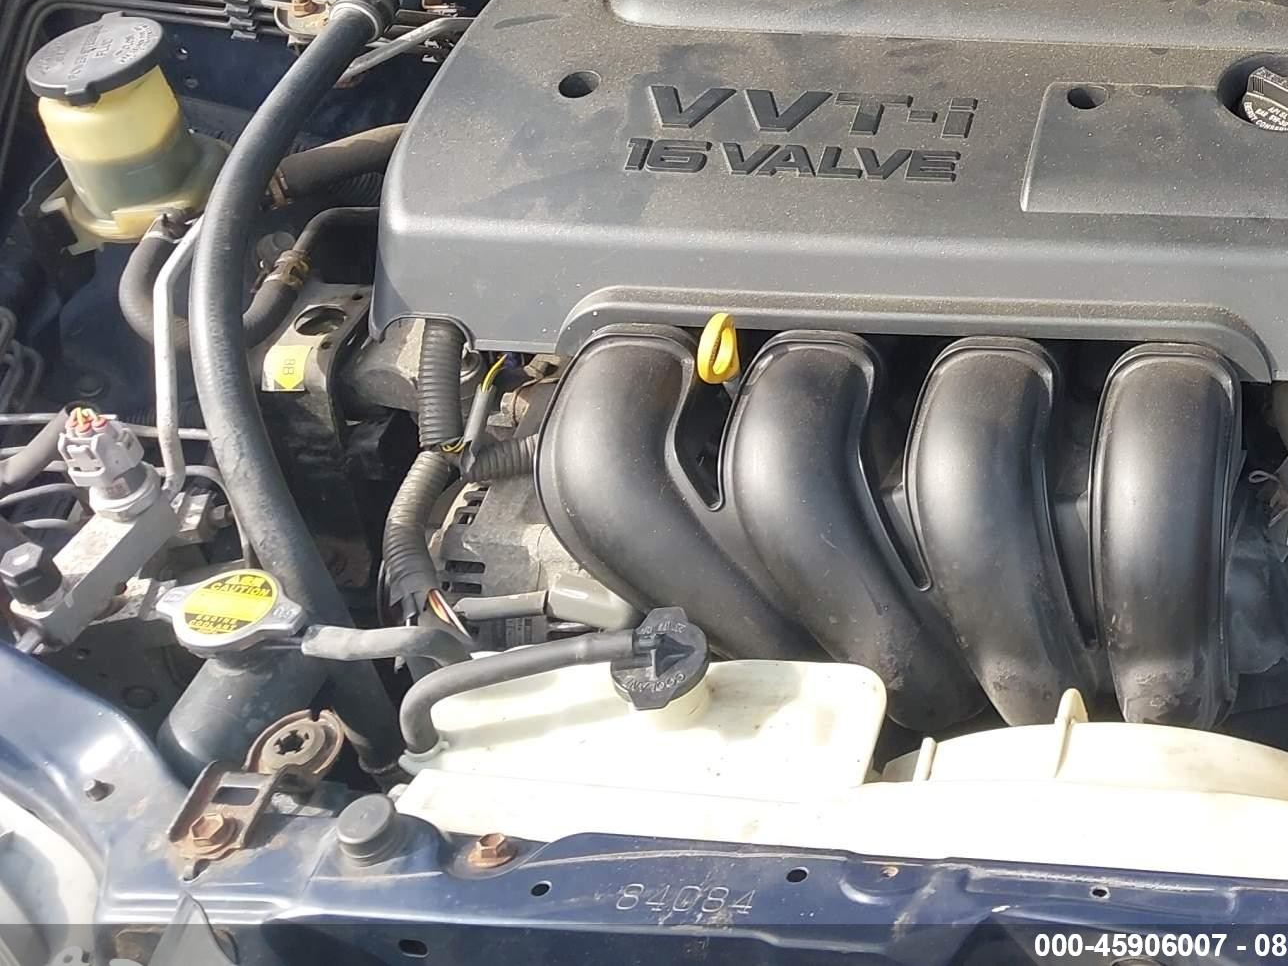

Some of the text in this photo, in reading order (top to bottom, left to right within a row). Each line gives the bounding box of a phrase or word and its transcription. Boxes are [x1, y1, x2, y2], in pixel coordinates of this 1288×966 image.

[648, 85, 979, 139] VVT-i
[624, 137, 962, 183] 16 VALVE
[210, 582, 272, 597] CAUTION
[615, 883, 756, 915] 84084
